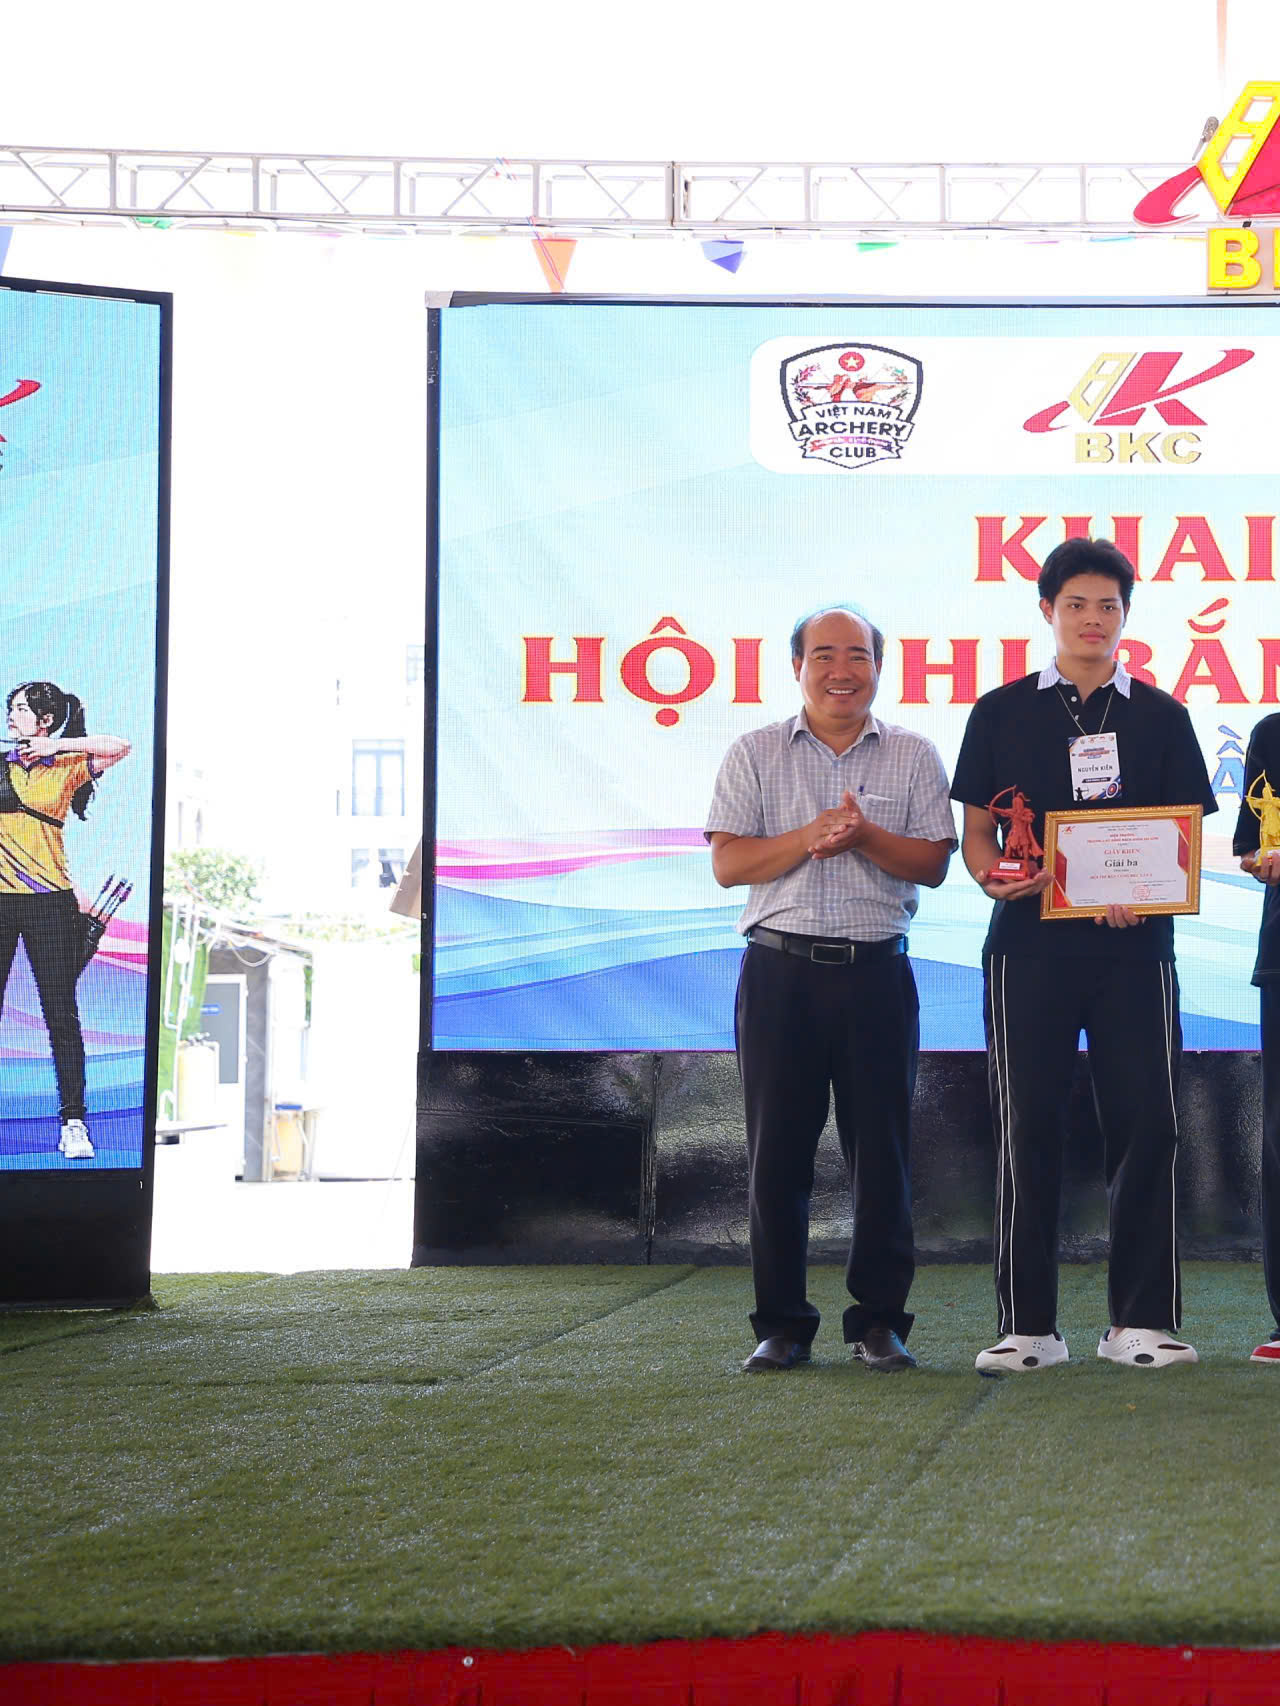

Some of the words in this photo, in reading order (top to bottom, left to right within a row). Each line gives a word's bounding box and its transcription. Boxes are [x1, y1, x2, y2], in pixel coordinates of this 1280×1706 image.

[815, 405, 849, 419] VIỆT
[854, 406, 892, 420] NAM
[798, 421, 907, 437] ARCHERY
[829, 446, 877, 458] CLUB
[1075, 431, 1203, 464] BKC
[522, 616, 764, 728] HỘI
